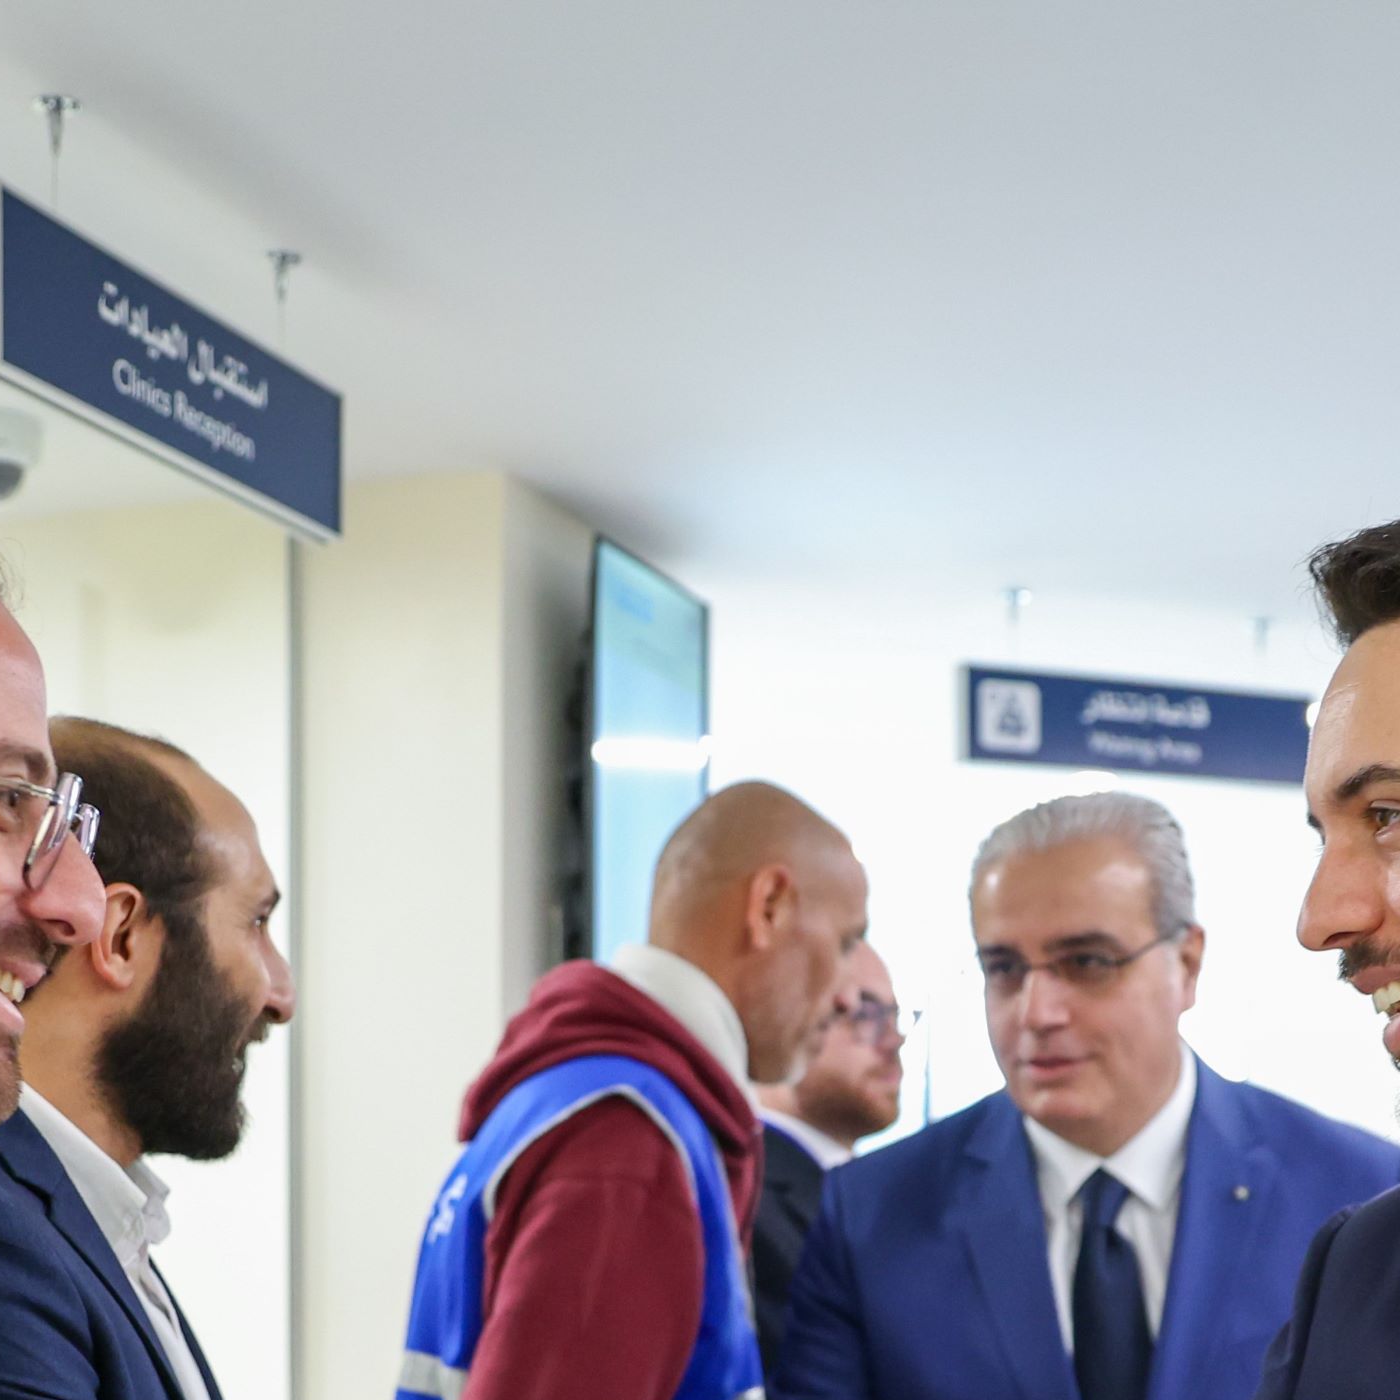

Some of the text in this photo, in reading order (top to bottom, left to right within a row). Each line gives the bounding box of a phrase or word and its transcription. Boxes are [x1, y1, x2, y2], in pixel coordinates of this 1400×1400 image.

[98, 281, 269, 411] استقبال العيادات
[112, 358, 256, 462] Clinics Reception
